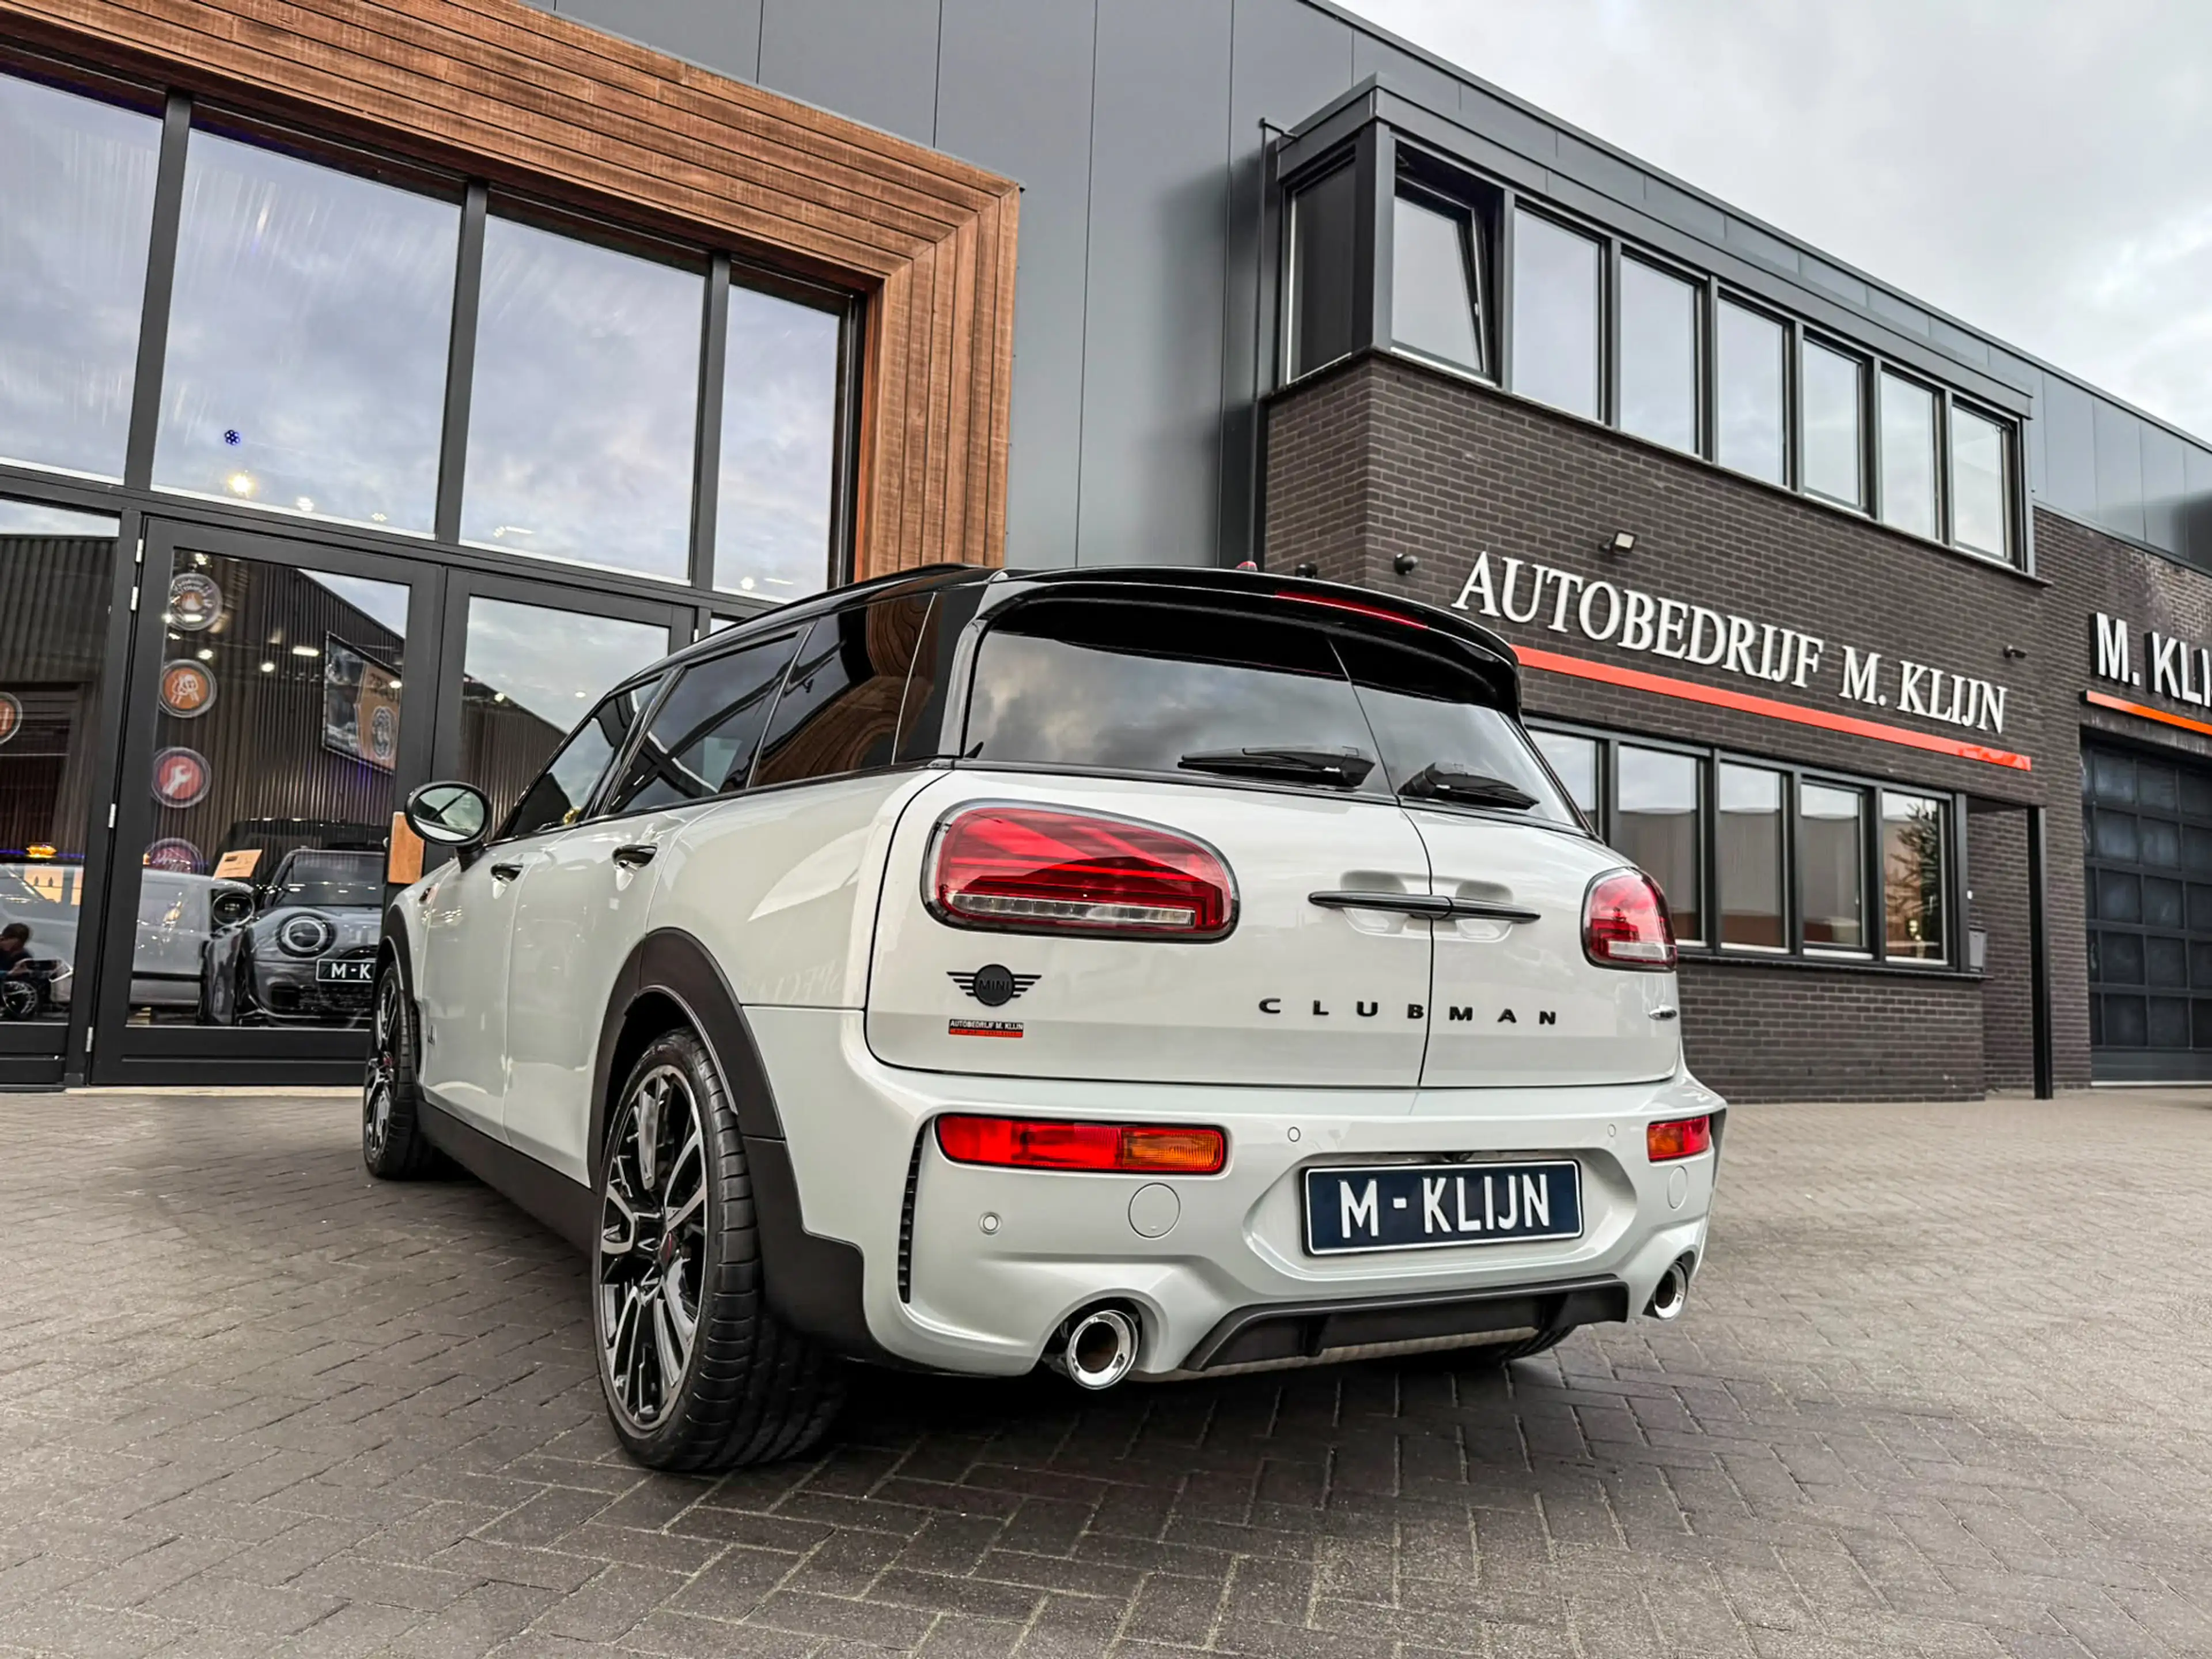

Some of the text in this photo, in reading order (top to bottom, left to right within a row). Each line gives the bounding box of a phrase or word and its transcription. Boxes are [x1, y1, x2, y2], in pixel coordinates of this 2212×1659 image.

[1450, 550, 2008, 735] AUTOBEDRIJF M. KLIJN
[2089, 611, 2212, 709] M. KLI
[331, 962, 372, 980] M-K
[979, 979, 1011, 991] MINI
[1259, 998, 1557, 1025] CLUBMAN
[950, 1020, 994, 1029] AUTOBEDRIJF
[1004, 1022, 1024, 1031] KLIJN
